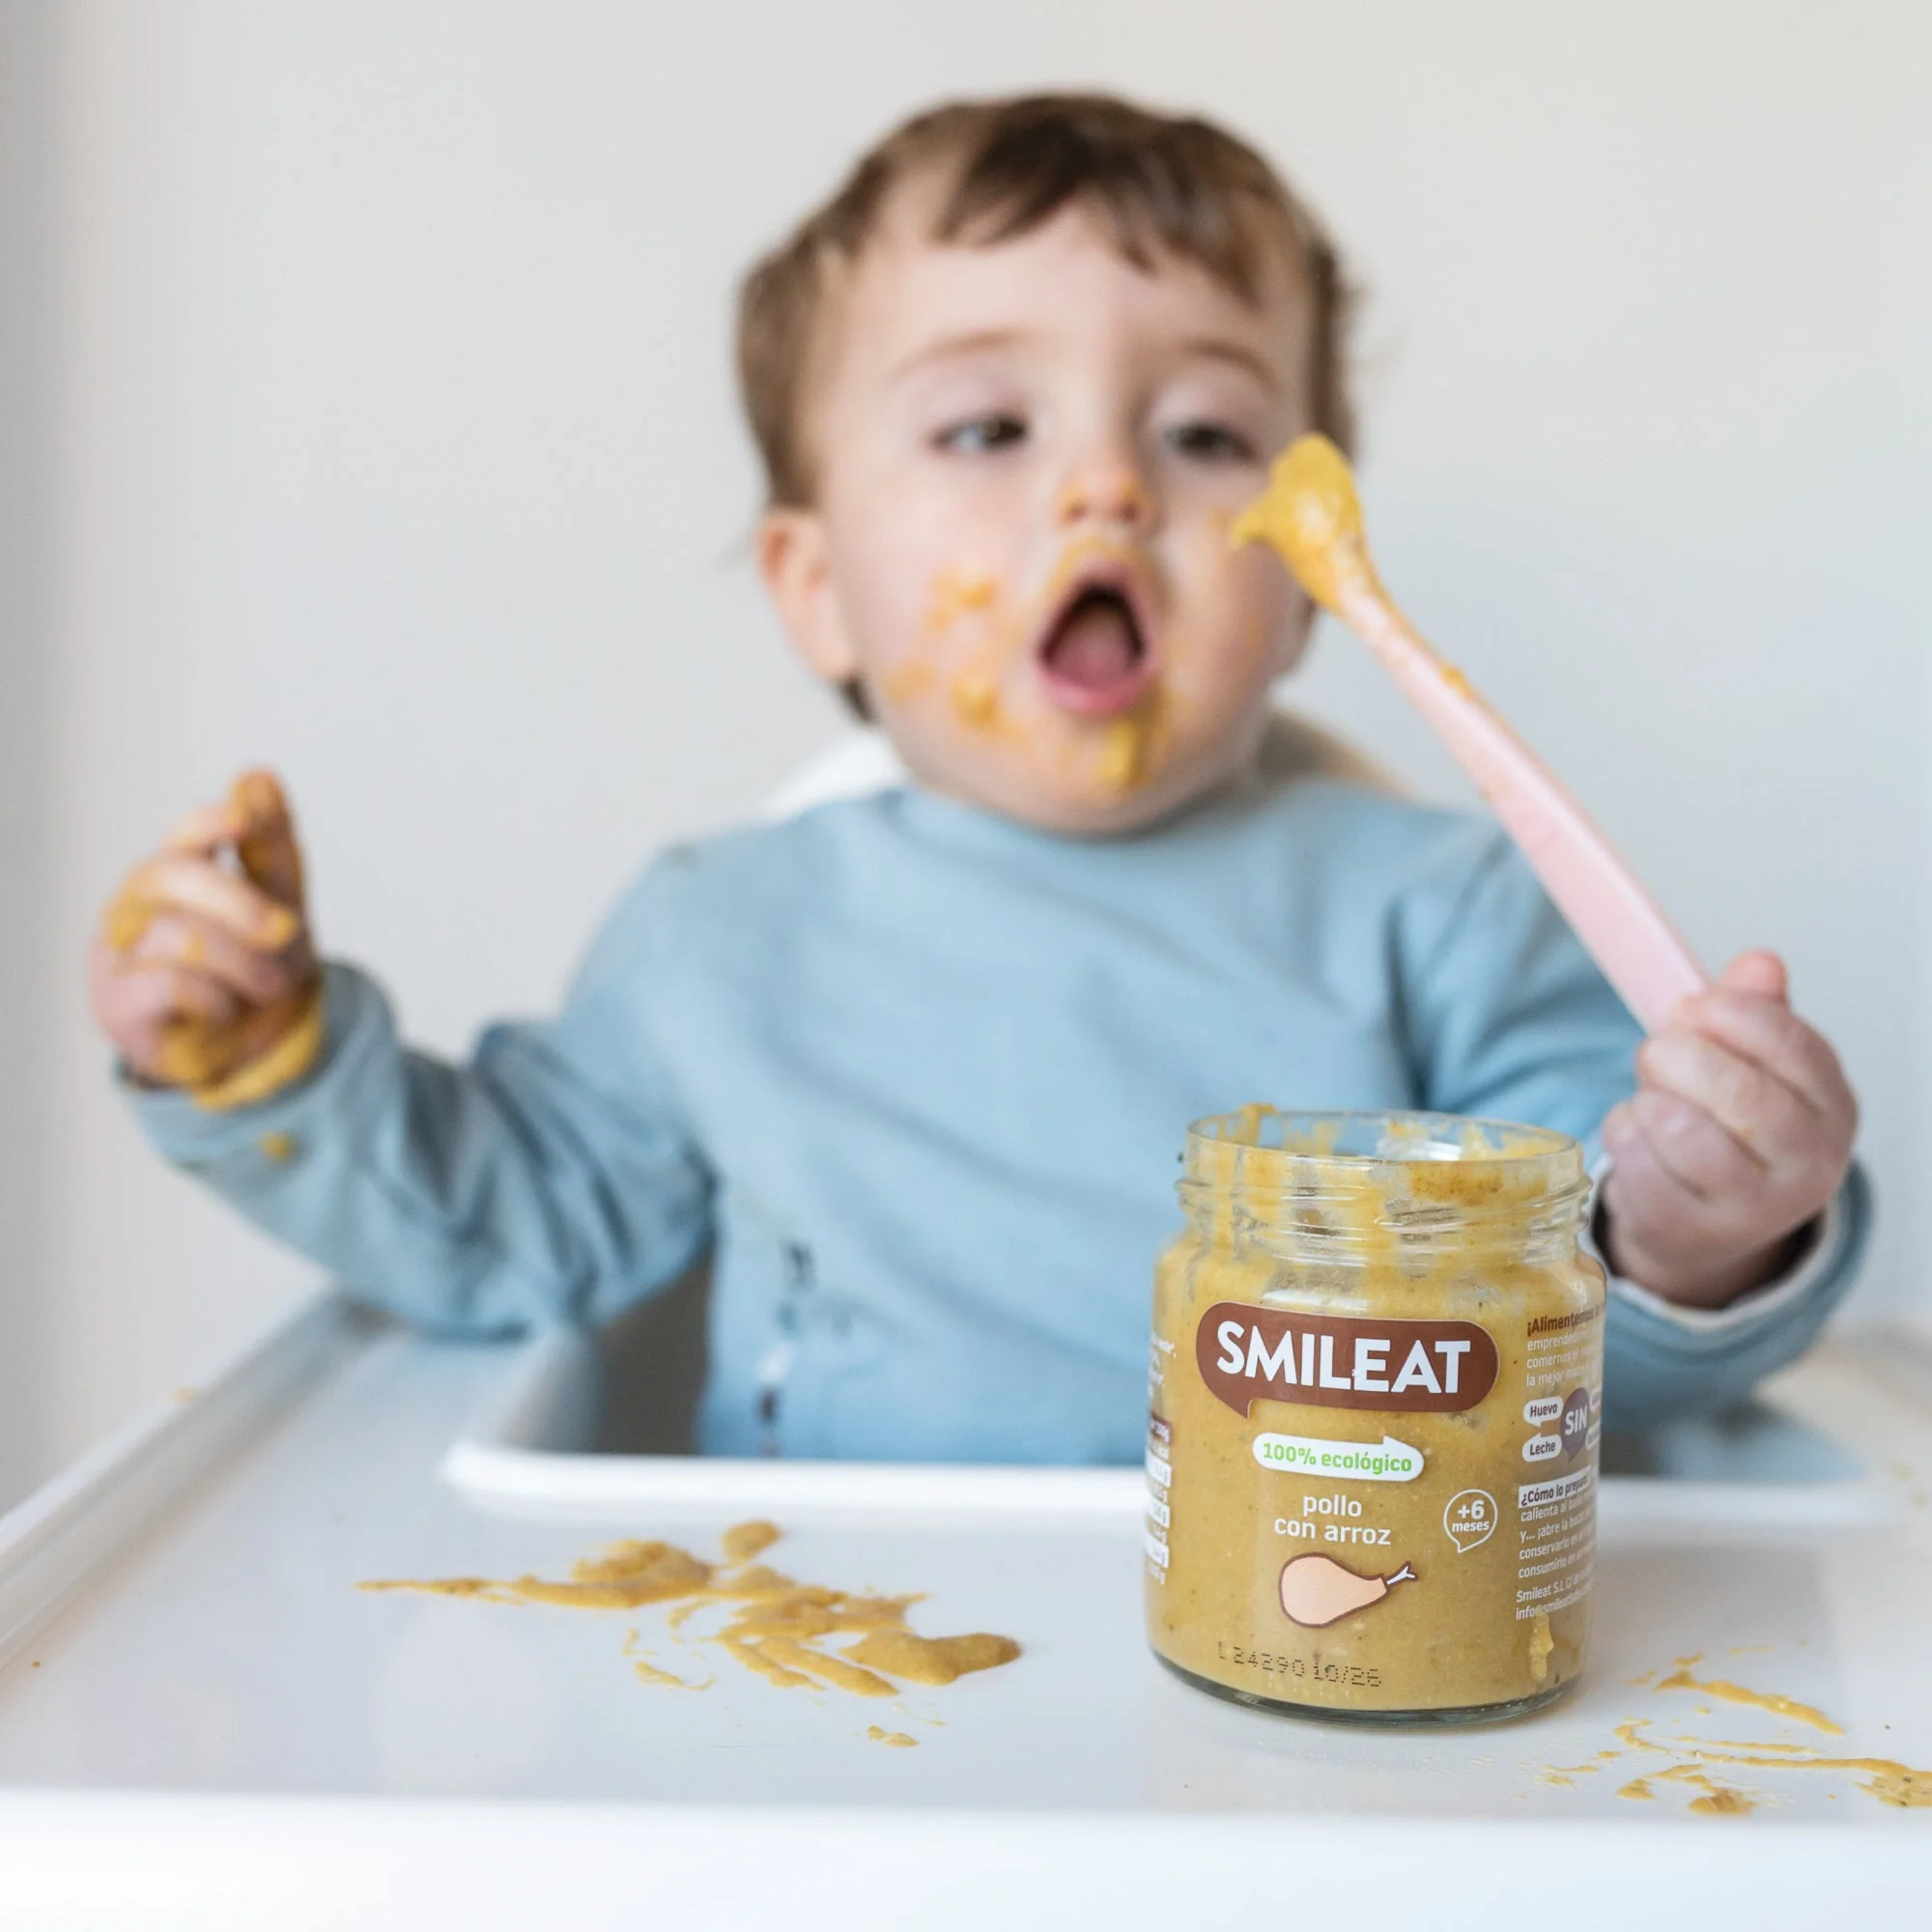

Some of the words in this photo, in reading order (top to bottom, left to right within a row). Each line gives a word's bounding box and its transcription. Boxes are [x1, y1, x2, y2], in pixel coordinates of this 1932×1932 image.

[1216, 1321, 1471, 1393] SMILEAT
[1526, 1372, 1536, 1387] la
[1529, 1403, 1558, 1418] Huevo
[1565, 1405, 1588, 1436] SIN
[1263, 1442, 1317, 1465] 100%
[1321, 1451, 1412, 1475] ecológico
[1529, 1440, 1556, 1457] Leche
[1302, 1494, 1363, 1518] pollo
[1520, 1487, 1555, 1507] ¿Cómo
[1555, 1483, 1565, 1497] lo
[1457, 1499, 1486, 1520] +6
[1520, 1503, 1558, 1522] calienta
[1274, 1517, 1317, 1539] con
[1323, 1522, 1392, 1546] arroz
[1452, 1520, 1490, 1533] meses
[1516, 1584, 1551, 1603] Smileat
[1233, 1646, 1305, 1677] 24290
[1313, 1662, 1382, 1688] 10/26
